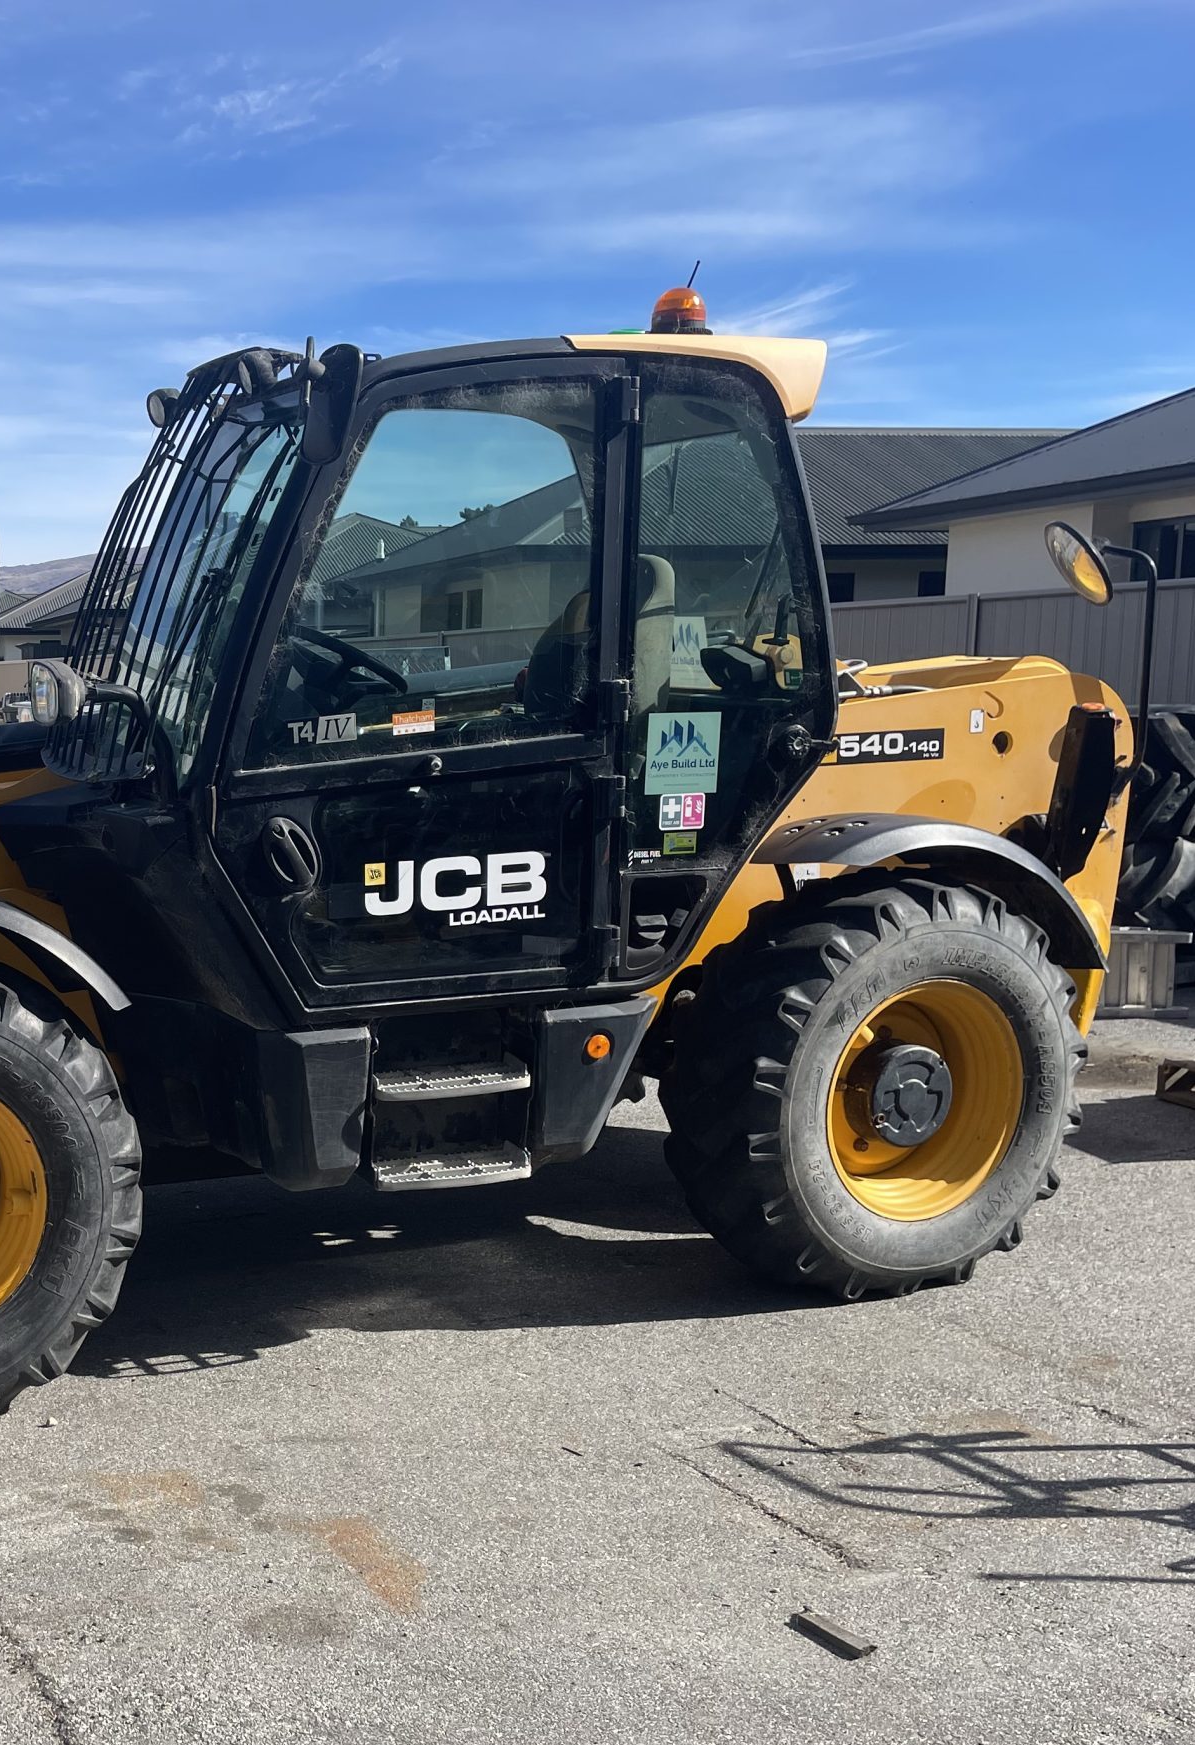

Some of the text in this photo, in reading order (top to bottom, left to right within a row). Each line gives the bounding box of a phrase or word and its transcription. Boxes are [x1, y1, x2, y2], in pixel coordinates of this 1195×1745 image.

[394, 713, 433, 725] Thatcham
[288, 717, 352, 744] T4 IV
[839, 732, 940, 758] 540-140
[650, 759, 715, 771] Aye Build Ltd
[364, 850, 547, 916] JCB
[370, 868, 382, 880] JCB
[449, 905, 546, 926] LOADALL
